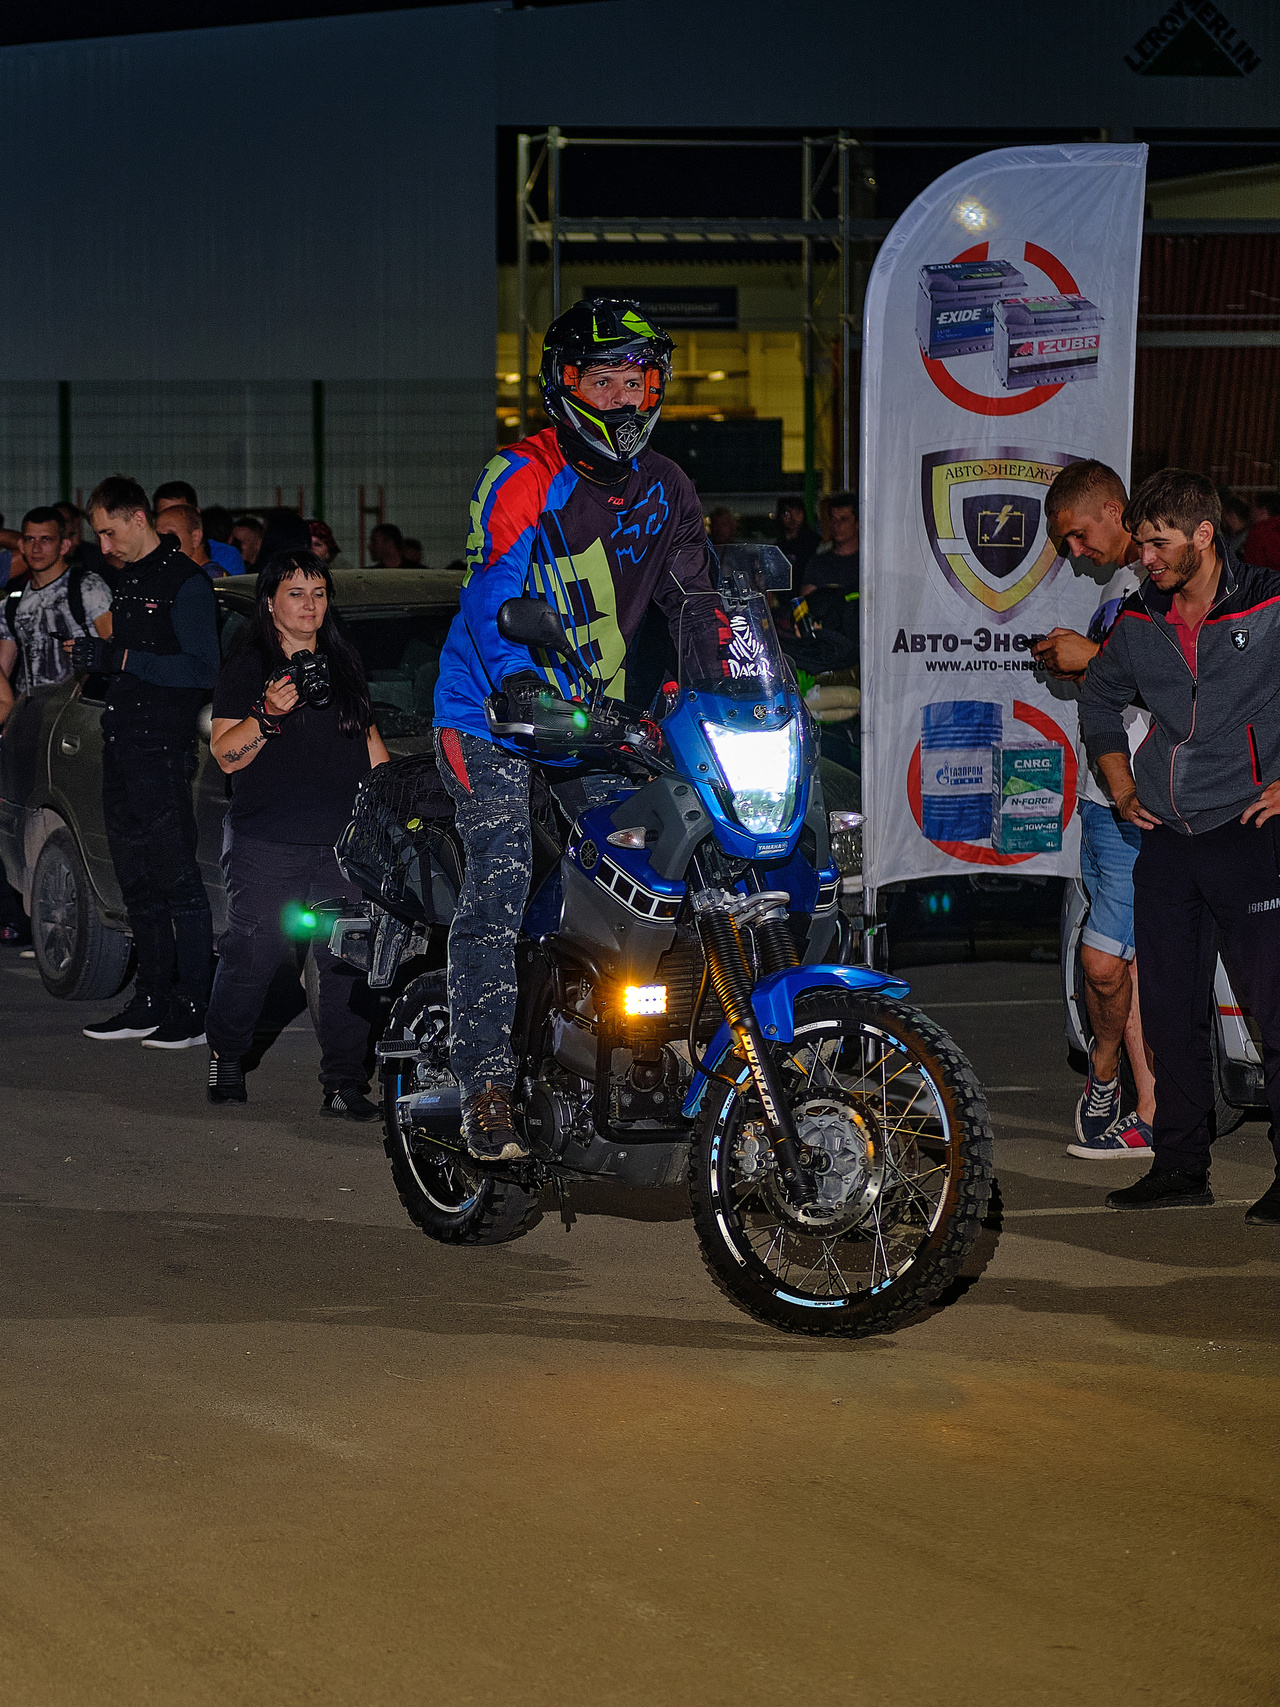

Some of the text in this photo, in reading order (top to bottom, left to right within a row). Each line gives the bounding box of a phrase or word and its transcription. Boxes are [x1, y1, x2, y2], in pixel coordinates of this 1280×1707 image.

[936, 308, 982, 325] EXIDE
[1042, 336, 1097, 354] ZUBR
[728, 657, 775, 679] DAKAR
[950, 766, 983, 777] ГАЗПРОМ
[741, 1034, 780, 1126] DUNLOP
